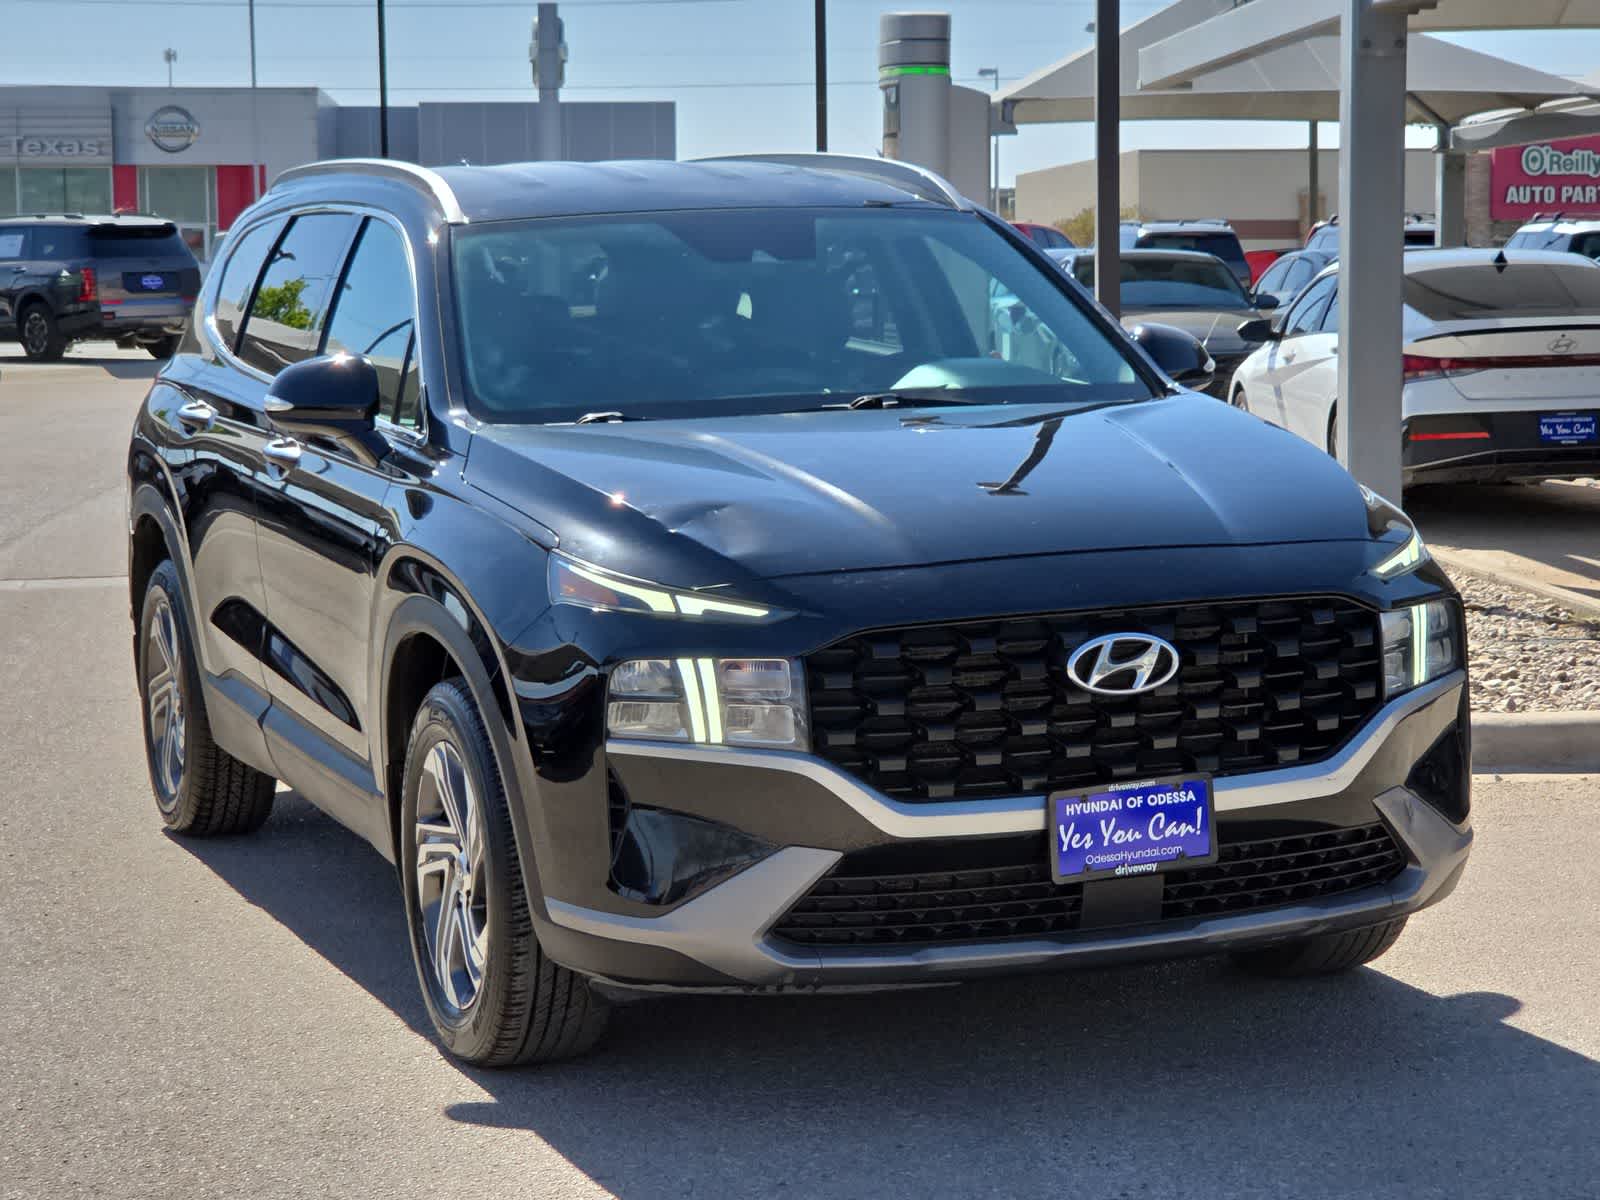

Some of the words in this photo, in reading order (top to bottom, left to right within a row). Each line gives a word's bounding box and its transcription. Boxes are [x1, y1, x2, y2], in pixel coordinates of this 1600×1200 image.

[151, 122, 195, 138] NISSAN
[9, 136, 100, 155] Texas
[1522, 146, 1600, 177] O'Reilly
[1506, 186, 1555, 203] AUTO
[1561, 186, 1600, 203] PAR
[1108, 780, 1156, 792] driveway.com
[1066, 798, 1123, 816] HYUNDAI
[1126, 796, 1144, 808] OF
[1147, 790, 1196, 806] ODESSA
[1059, 822, 1094, 852] Yes
[1100, 817, 1142, 847] You
[1148, 806, 1203, 841] Can!
[1085, 846, 1182, 864] OdessaHyundai.com
[1115, 862, 1158, 876] driveway
